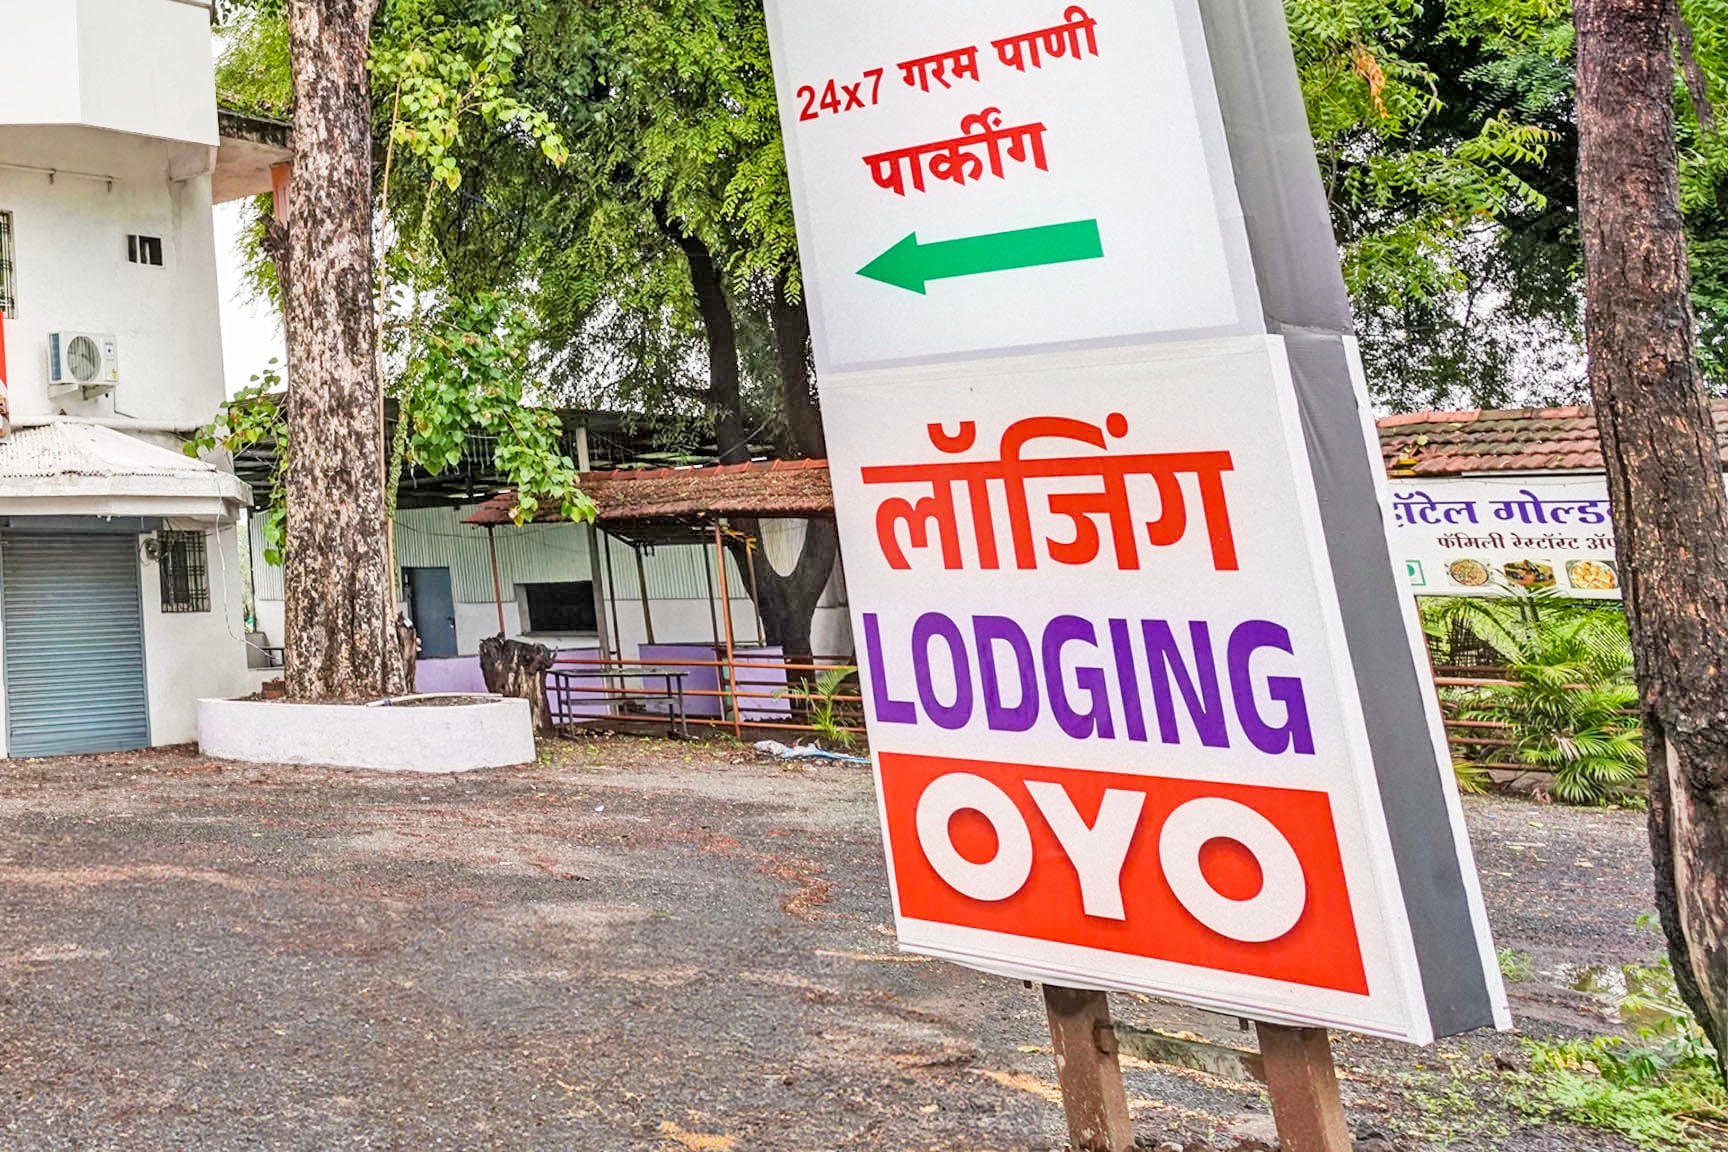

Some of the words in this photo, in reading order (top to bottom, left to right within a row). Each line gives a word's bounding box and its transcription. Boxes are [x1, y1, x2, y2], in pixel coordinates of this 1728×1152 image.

[795, 67, 884, 122] 24x7
[897, 45, 980, 93] गरम
[990, 5, 1100, 73] पाणी
[862, 106, 1049, 197] पार्कींग
[860, 412, 1240, 571] लॉजिंग
[1489, 489, 1613, 525] गोल्ड
[862, 611, 1316, 755] LODGING
[915, 772, 1307, 943] OYO
